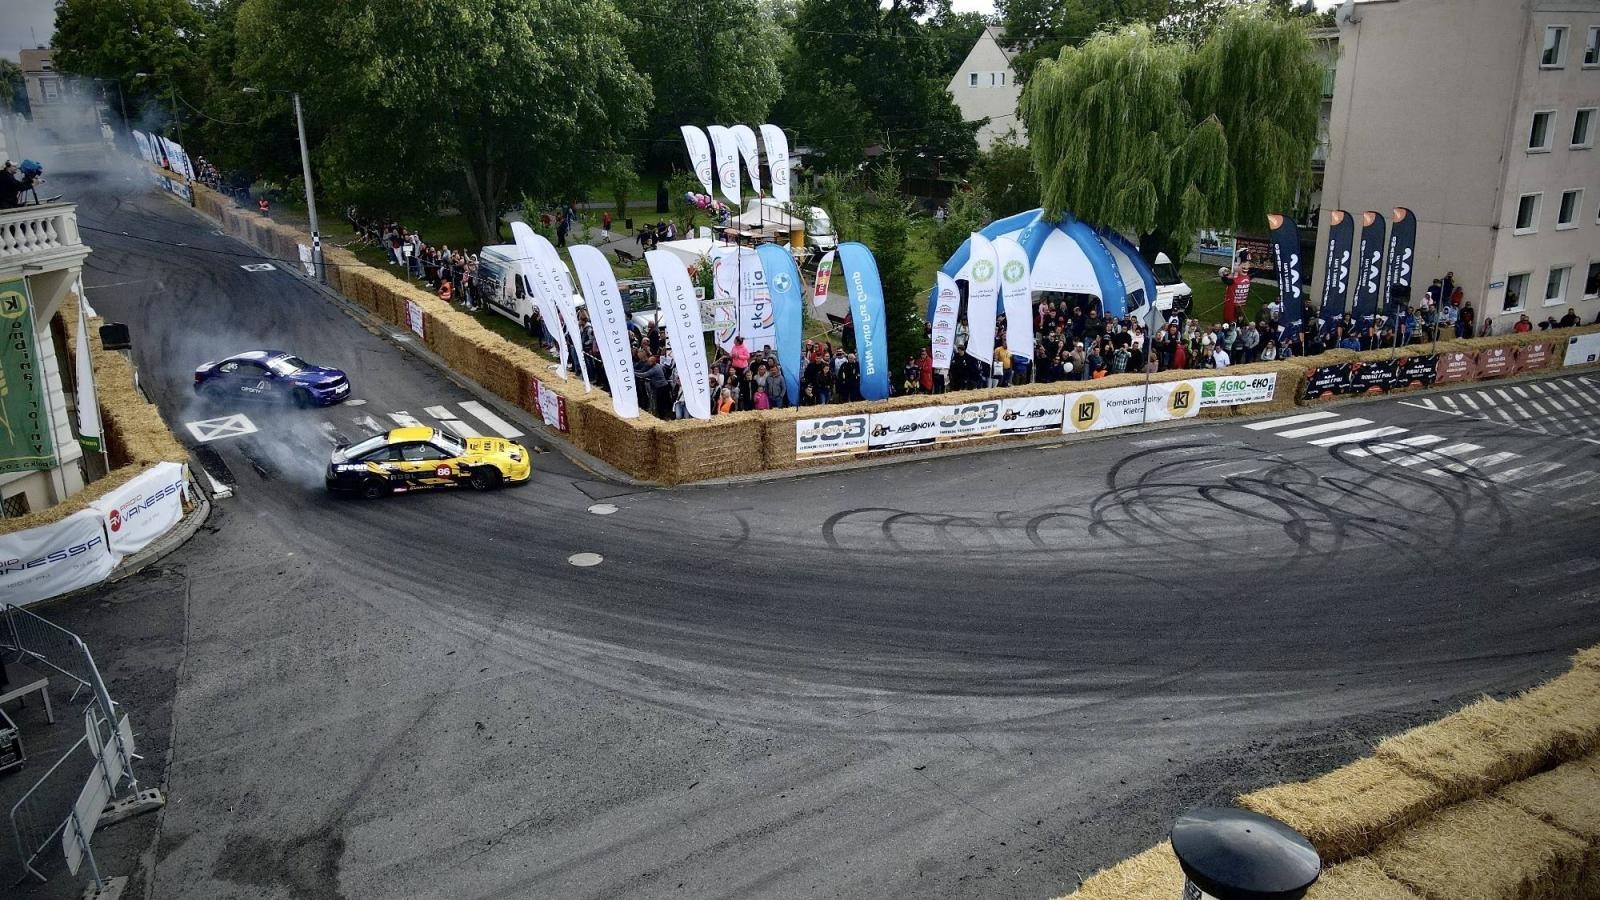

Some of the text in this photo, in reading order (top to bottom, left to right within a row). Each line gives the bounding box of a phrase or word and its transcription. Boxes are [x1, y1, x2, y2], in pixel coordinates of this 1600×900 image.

[1219, 378, 1269, 391] AGRO-EKO
[1106, 396, 1141, 408] Kombinat
[940, 403, 999, 428] JCB
[1123, 406, 1145, 416] Kietrz
[799, 418, 866, 443] JCB
[337, 463, 368, 471] areon
[437, 467, 450, 475] 86
[119, 494, 143, 511] RADIO
[120, 479, 183, 522] VANESSA
[0, 535, 102, 577] NESSA
[0, 558, 19, 568] IO
